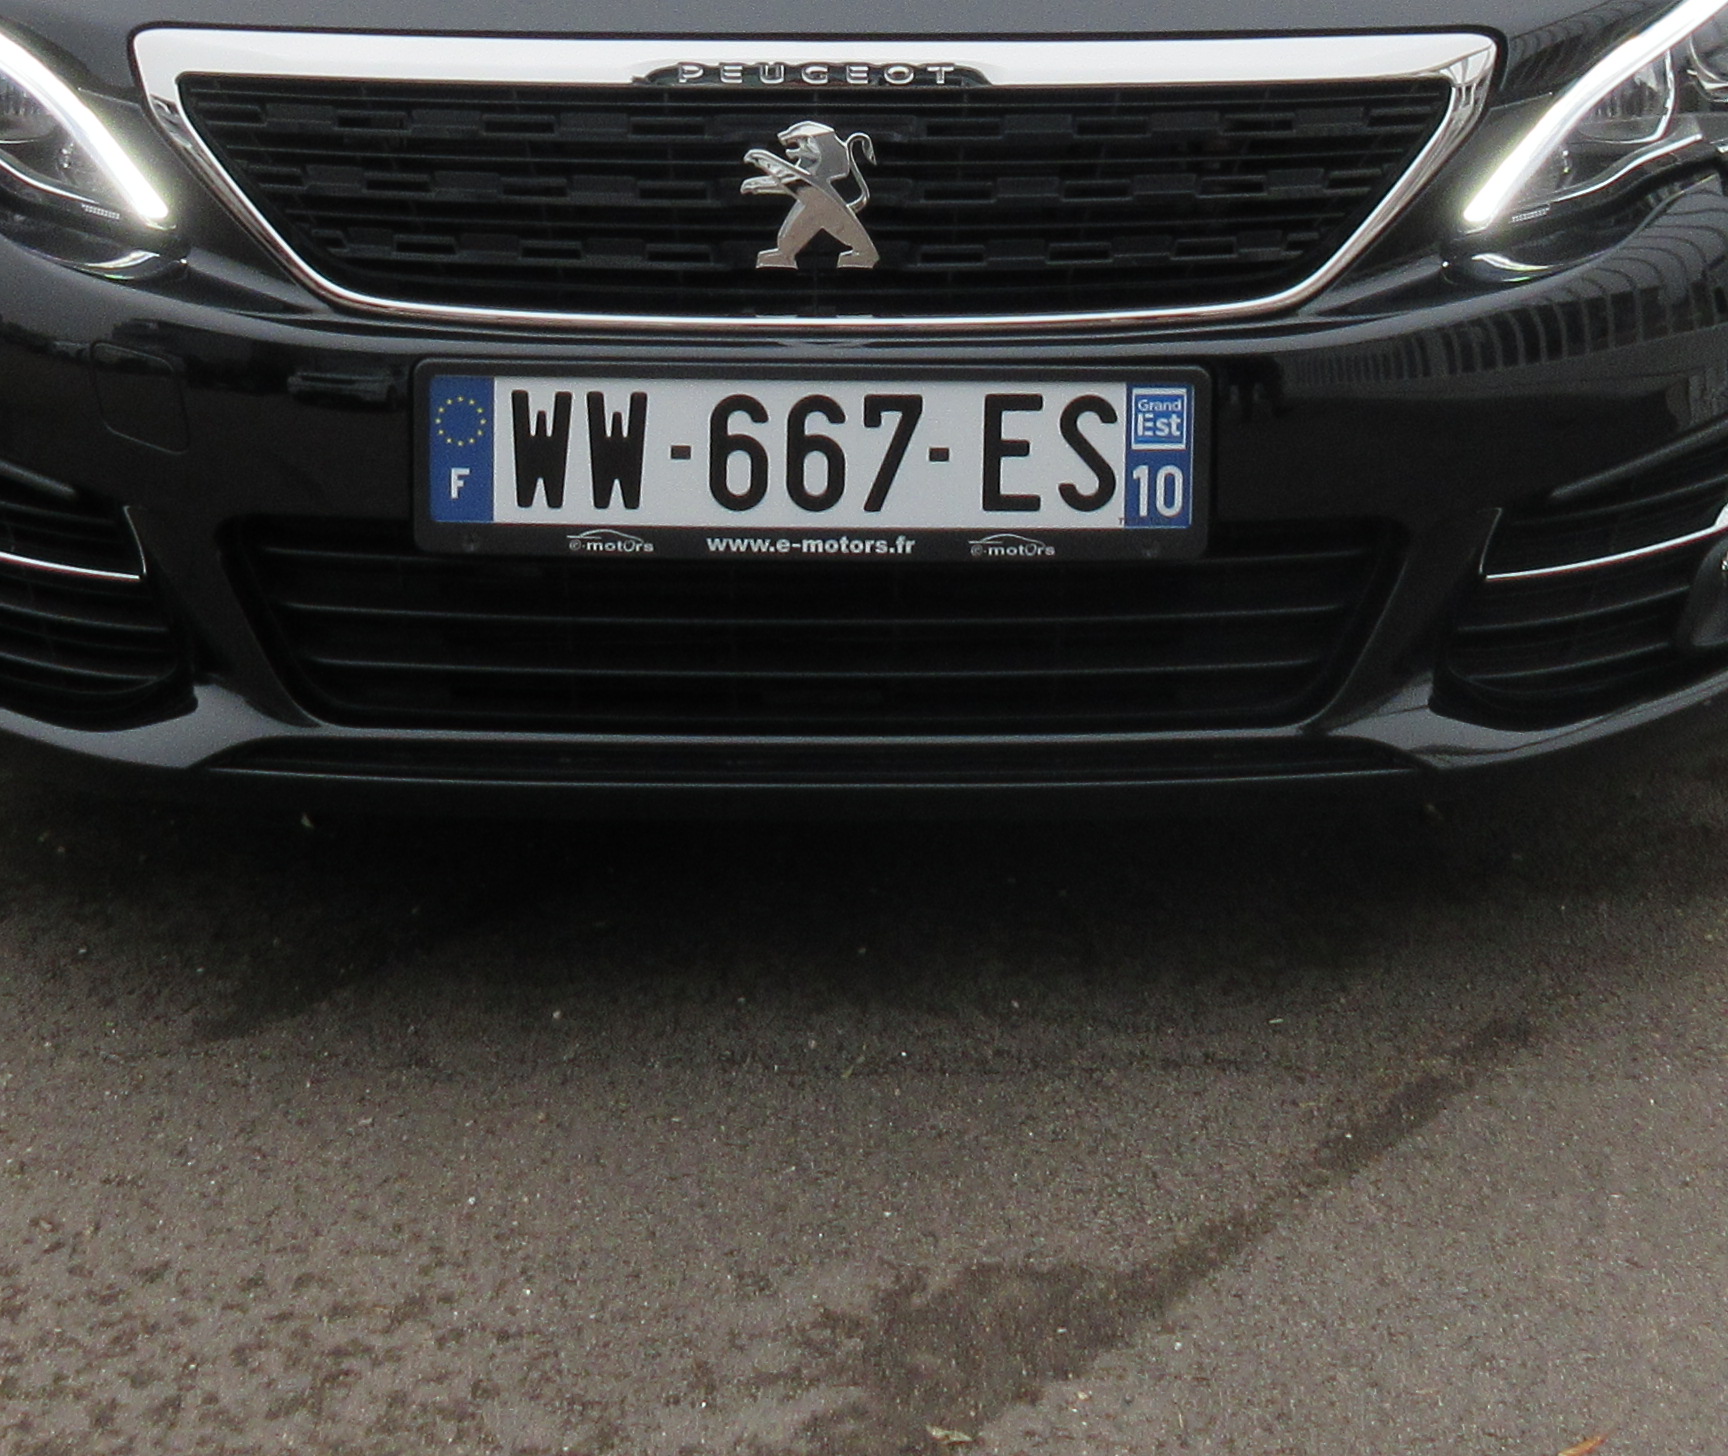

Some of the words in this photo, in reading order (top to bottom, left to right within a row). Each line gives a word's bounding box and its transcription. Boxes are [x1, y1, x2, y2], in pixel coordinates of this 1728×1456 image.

[676, 63, 955, 85] PEUGEOT
[1138, 399, 1182, 411] Grand
[1137, 413, 1181, 436] Est
[450, 467, 470, 499] F
[1133, 465, 1183, 517] 10
[707, 536, 915, 554] www.e-motors.fr
